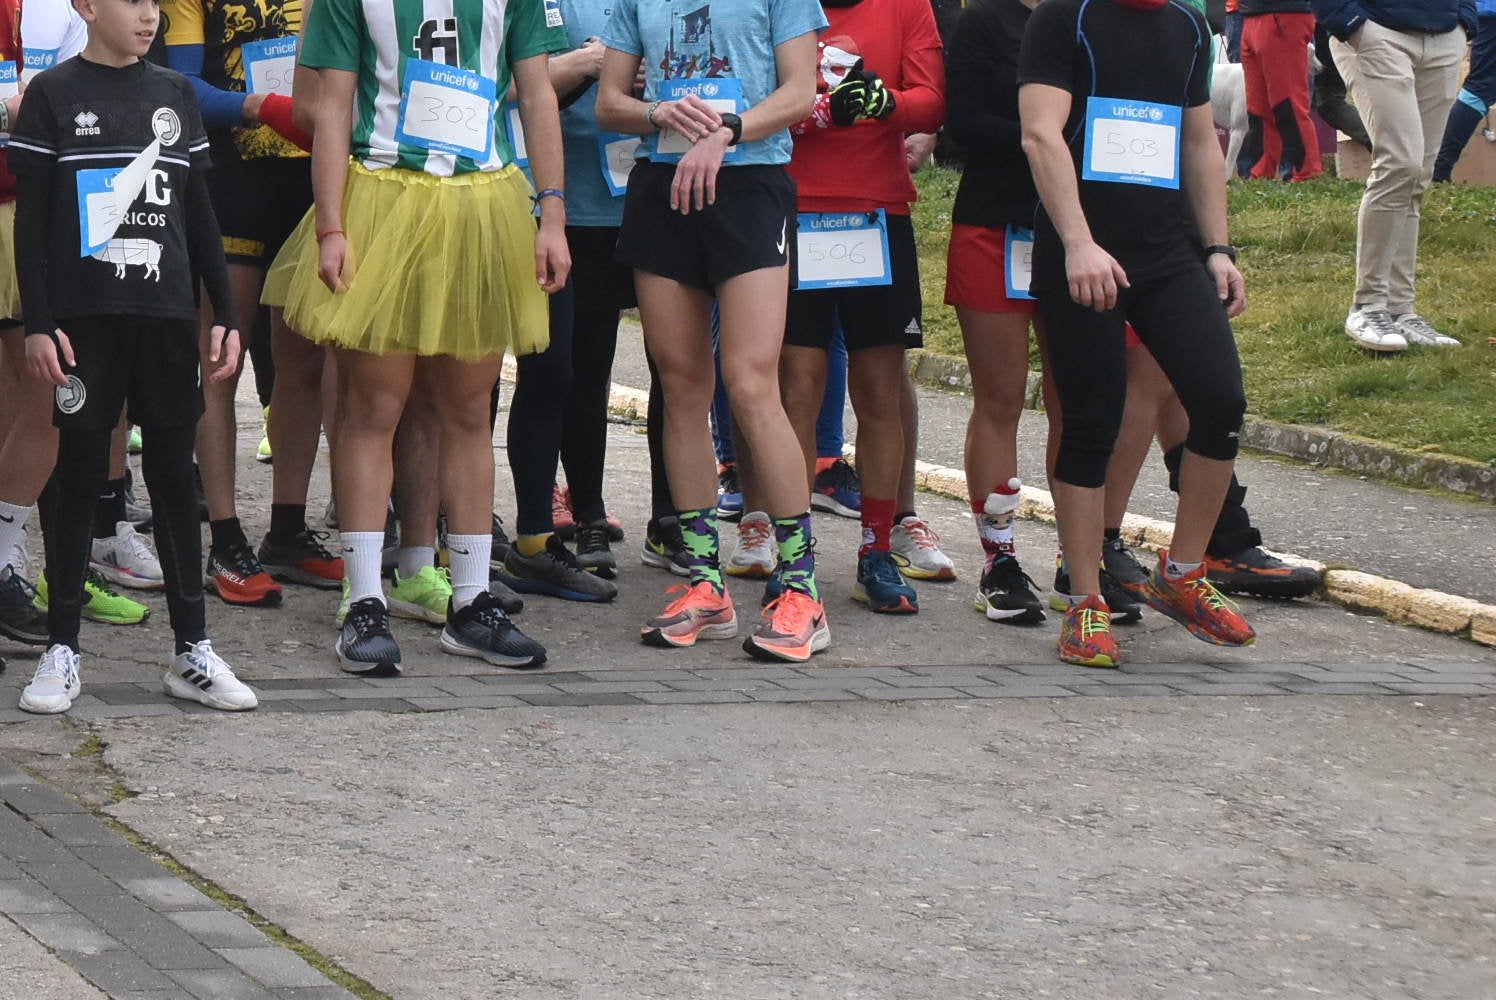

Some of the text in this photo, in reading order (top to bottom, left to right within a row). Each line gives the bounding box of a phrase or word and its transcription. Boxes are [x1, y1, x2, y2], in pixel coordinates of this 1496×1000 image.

[24, 52, 47, 65] icef
[430, 70, 467, 87] unicef
[671, 83, 703, 97] unicef
[421, 96, 479, 132] 302
[1112, 105, 1150, 119] unicef
[1106, 132, 1159, 158] 503
[120, 211, 167, 227] RICOS
[810, 215, 848, 230] unicef
[808, 241, 866, 264] 506
[213, 558, 246, 586] MERRELL
